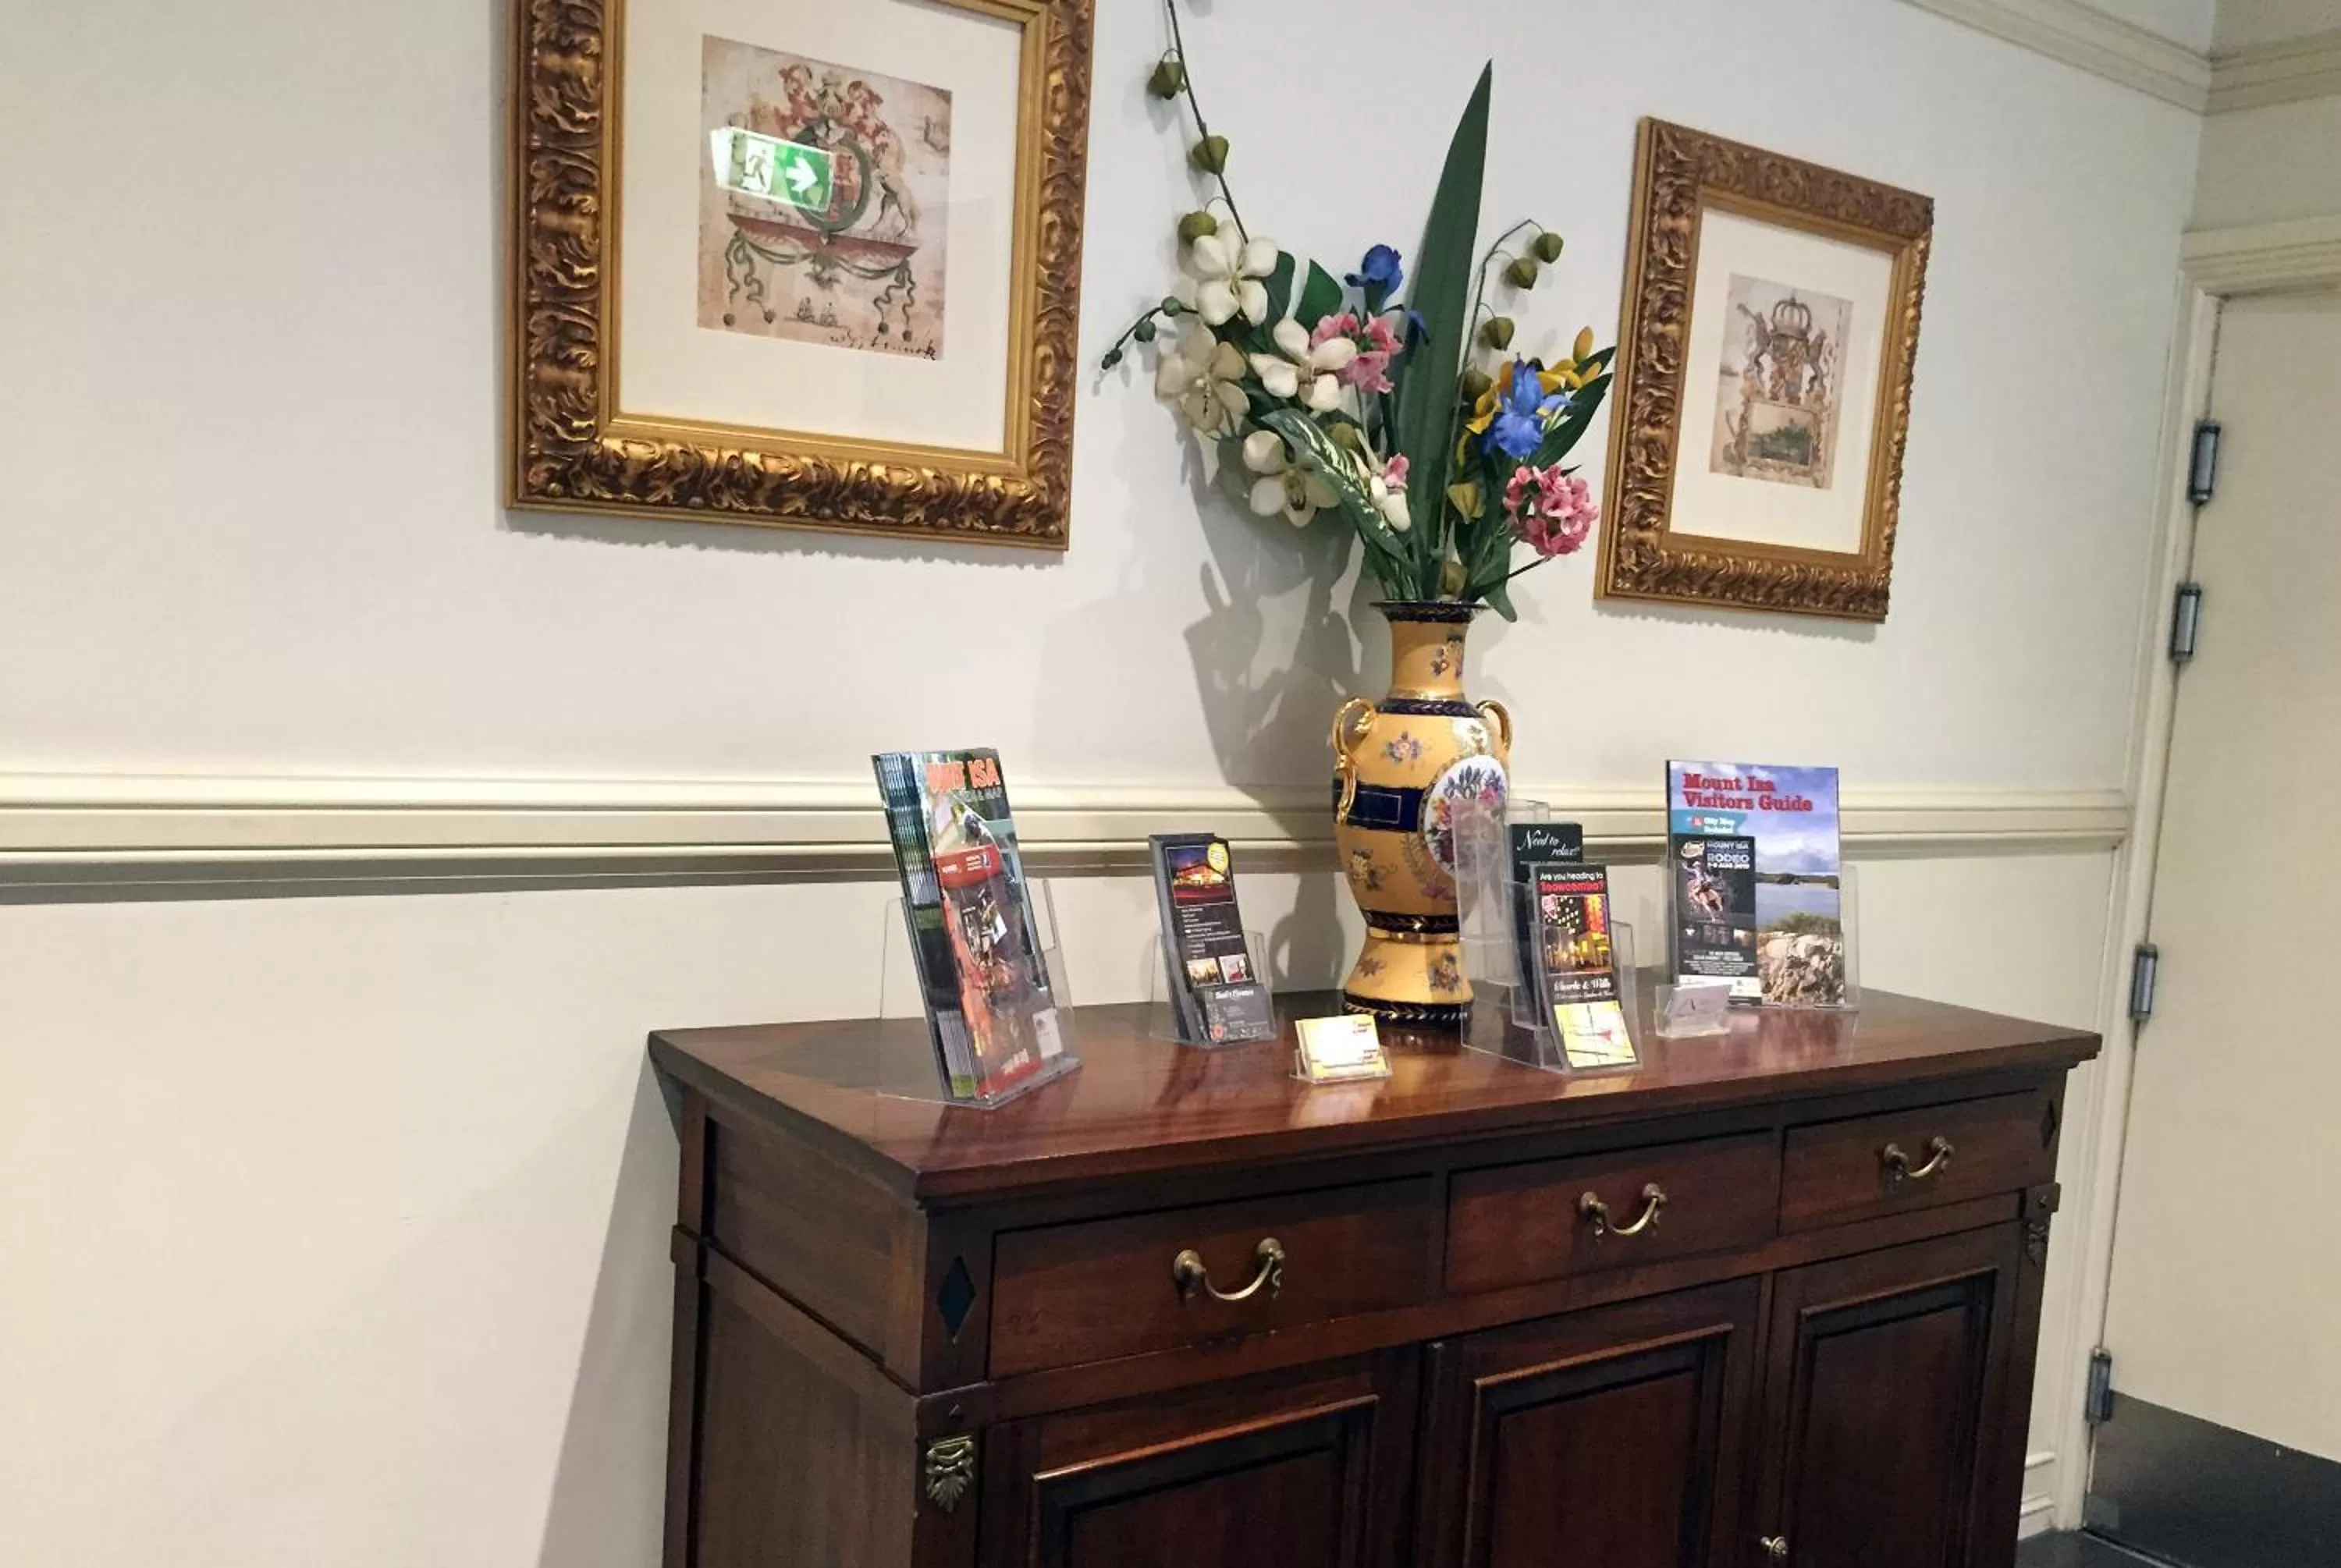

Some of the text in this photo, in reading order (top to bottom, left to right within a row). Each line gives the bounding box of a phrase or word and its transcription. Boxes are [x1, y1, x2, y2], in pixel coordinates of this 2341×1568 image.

[968, 757, 1000, 789] ISA
[1682, 772, 1776, 792] Mount Isa
[1682, 790, 1813, 812] Visitors Guide
[1516, 829, 1560, 851] Need to
[1707, 853, 1750, 863] RODEO
[1540, 872, 1552, 881] Are
[1552, 873, 1565, 882] you
[1566, 871, 1595, 881] heading
